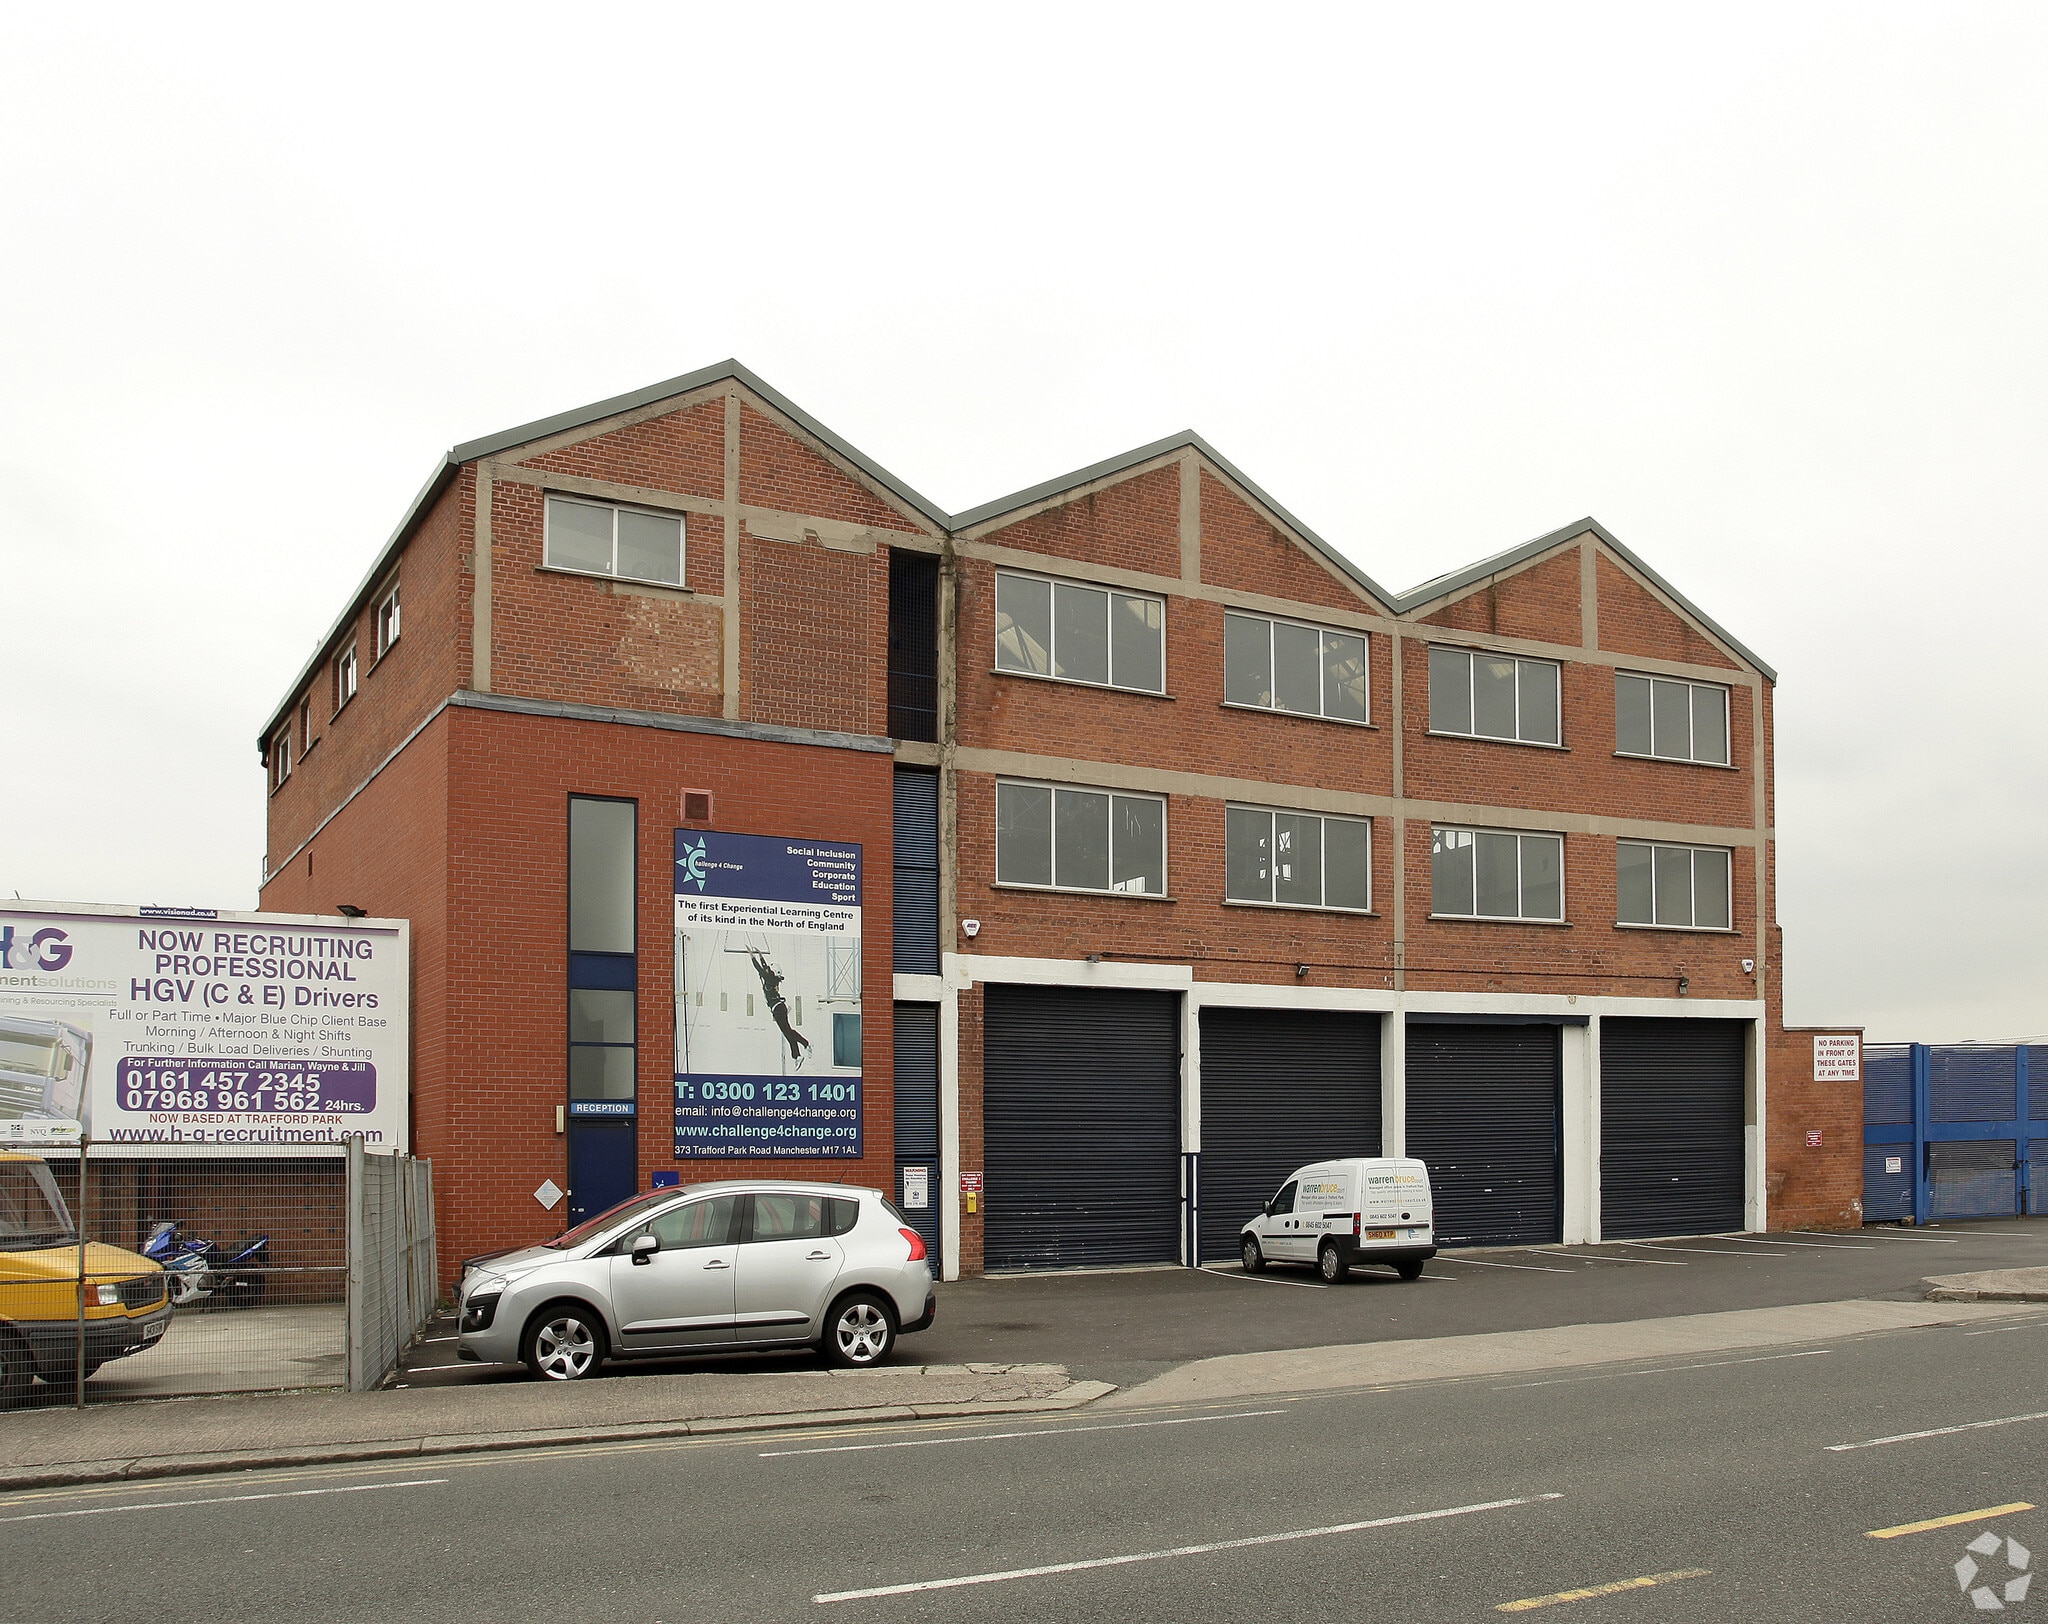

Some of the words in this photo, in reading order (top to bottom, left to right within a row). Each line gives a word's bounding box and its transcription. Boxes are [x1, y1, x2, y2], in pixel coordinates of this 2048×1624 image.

[787, 846, 814, 856] Social
[816, 849, 856, 859] Inclusion
[723, 862, 743, 871] Change
[807, 859, 856, 871] Community
[812, 870, 856, 881] Corporate
[812, 881, 856, 891] Education
[832, 892, 856, 902] Sport
[140, 908, 217, 918] www.visionad.co.uk
[678, 900, 697, 910] The
[699, 901, 719, 911] first
[721, 903, 778, 915] Experiential
[780, 906, 821, 920] Learning
[823, 909, 854, 920] Centre
[687, 913, 697, 922] of
[700, 914, 712, 923] its
[715, 915, 735, 924] kind
[738, 916, 747, 925] in
[749, 917, 765, 926] the
[767, 918, 794, 928] North
[795, 920, 805, 929] of
[808, 921, 845, 932] England
[139, 929, 204, 952] NOW
[214, 933, 373, 960] RECRUITING
[156, 954, 357, 981] PROFESSIONAL
[131, 978, 195, 1002] HGV
[203, 982, 229, 1008] (C
[238, 984, 254, 1005] &
[263, 985, 286, 1010] E)
[295, 986, 379, 1009] Drivers
[30, 997, 76, 1007] Resourcing
[78, 998, 117, 1007] Specialists
[109, 1009, 131, 1020] Full
[135, 1012, 148, 1021] or
[152, 1010, 177, 1021] Part
[181, 1011, 211, 1022] Time
[222, 1012, 257, 1026] Major
[260, 1014, 287, 1025] Blue
[290, 1014, 318, 1026] Chip
[321, 1015, 354, 1026] Client
[358, 1016, 387, 1027] Base
[145, 1026, 196, 1040] Morning
[208, 1027, 268, 1039] Afternoon
[271, 1029, 280, 1040] &
[284, 1029, 315, 1043] Night
[319, 1029, 351, 1041] Shifts
[123, 1041, 175, 1055] Trunking
[187, 1043, 214, 1053] Bulk
[218, 1043, 249, 1054] Load
[253, 1044, 310, 1056] Deliveries
[321, 1046, 372, 1059] Shunting
[127, 1058, 145, 1067] For
[148, 1058, 185, 1068] Further
[188, 1059, 245, 1069] Information
[248, 1060, 267, 1070] Call
[269, 1061, 305, 1072] Marian,
[307, 1062, 339, 1072] Wayne
[342, 1062, 349, 1071] &
[351, 1063, 366, 1072] Jill
[127, 1070, 190, 1089] 0161
[201, 1071, 249, 1090] 457
[258, 1072, 320, 1091] 2345
[675, 1081, 695, 1099] T:
[702, 1081, 755, 1101] 0300
[762, 1083, 801, 1101] 123
[808, 1084, 856, 1101] 1401
[127, 1090, 209, 1109] 07968
[217, 1091, 262, 1110] 961
[274, 1092, 320, 1111] 562
[325, 1100, 365, 1111] 24hrs.
[576, 1104, 629, 1112] RECEPTION
[675, 1106, 708, 1117] email:
[711, 1105, 857, 1120] info@challenge4change.org
[149, 1113, 179, 1123] NOW
[183, 1114, 224, 1124] BASED
[227, 1114, 241, 1124] AT
[245, 1114, 309, 1124] TRAFFORD
[312, 1115, 343, 1125] PARK
[675, 1125, 857, 1139] www.challenge4change.org
[674, 1146, 691, 1154] 373
[693, 1146, 725, 1155] Trafford
[728, 1146, 747, 1155] Park
[749, 1146, 771, 1154] Road
[774, 1146, 820, 1154] Manchester
[822, 1146, 840, 1154] M17
[842, 1146, 857, 1154] 1AL
